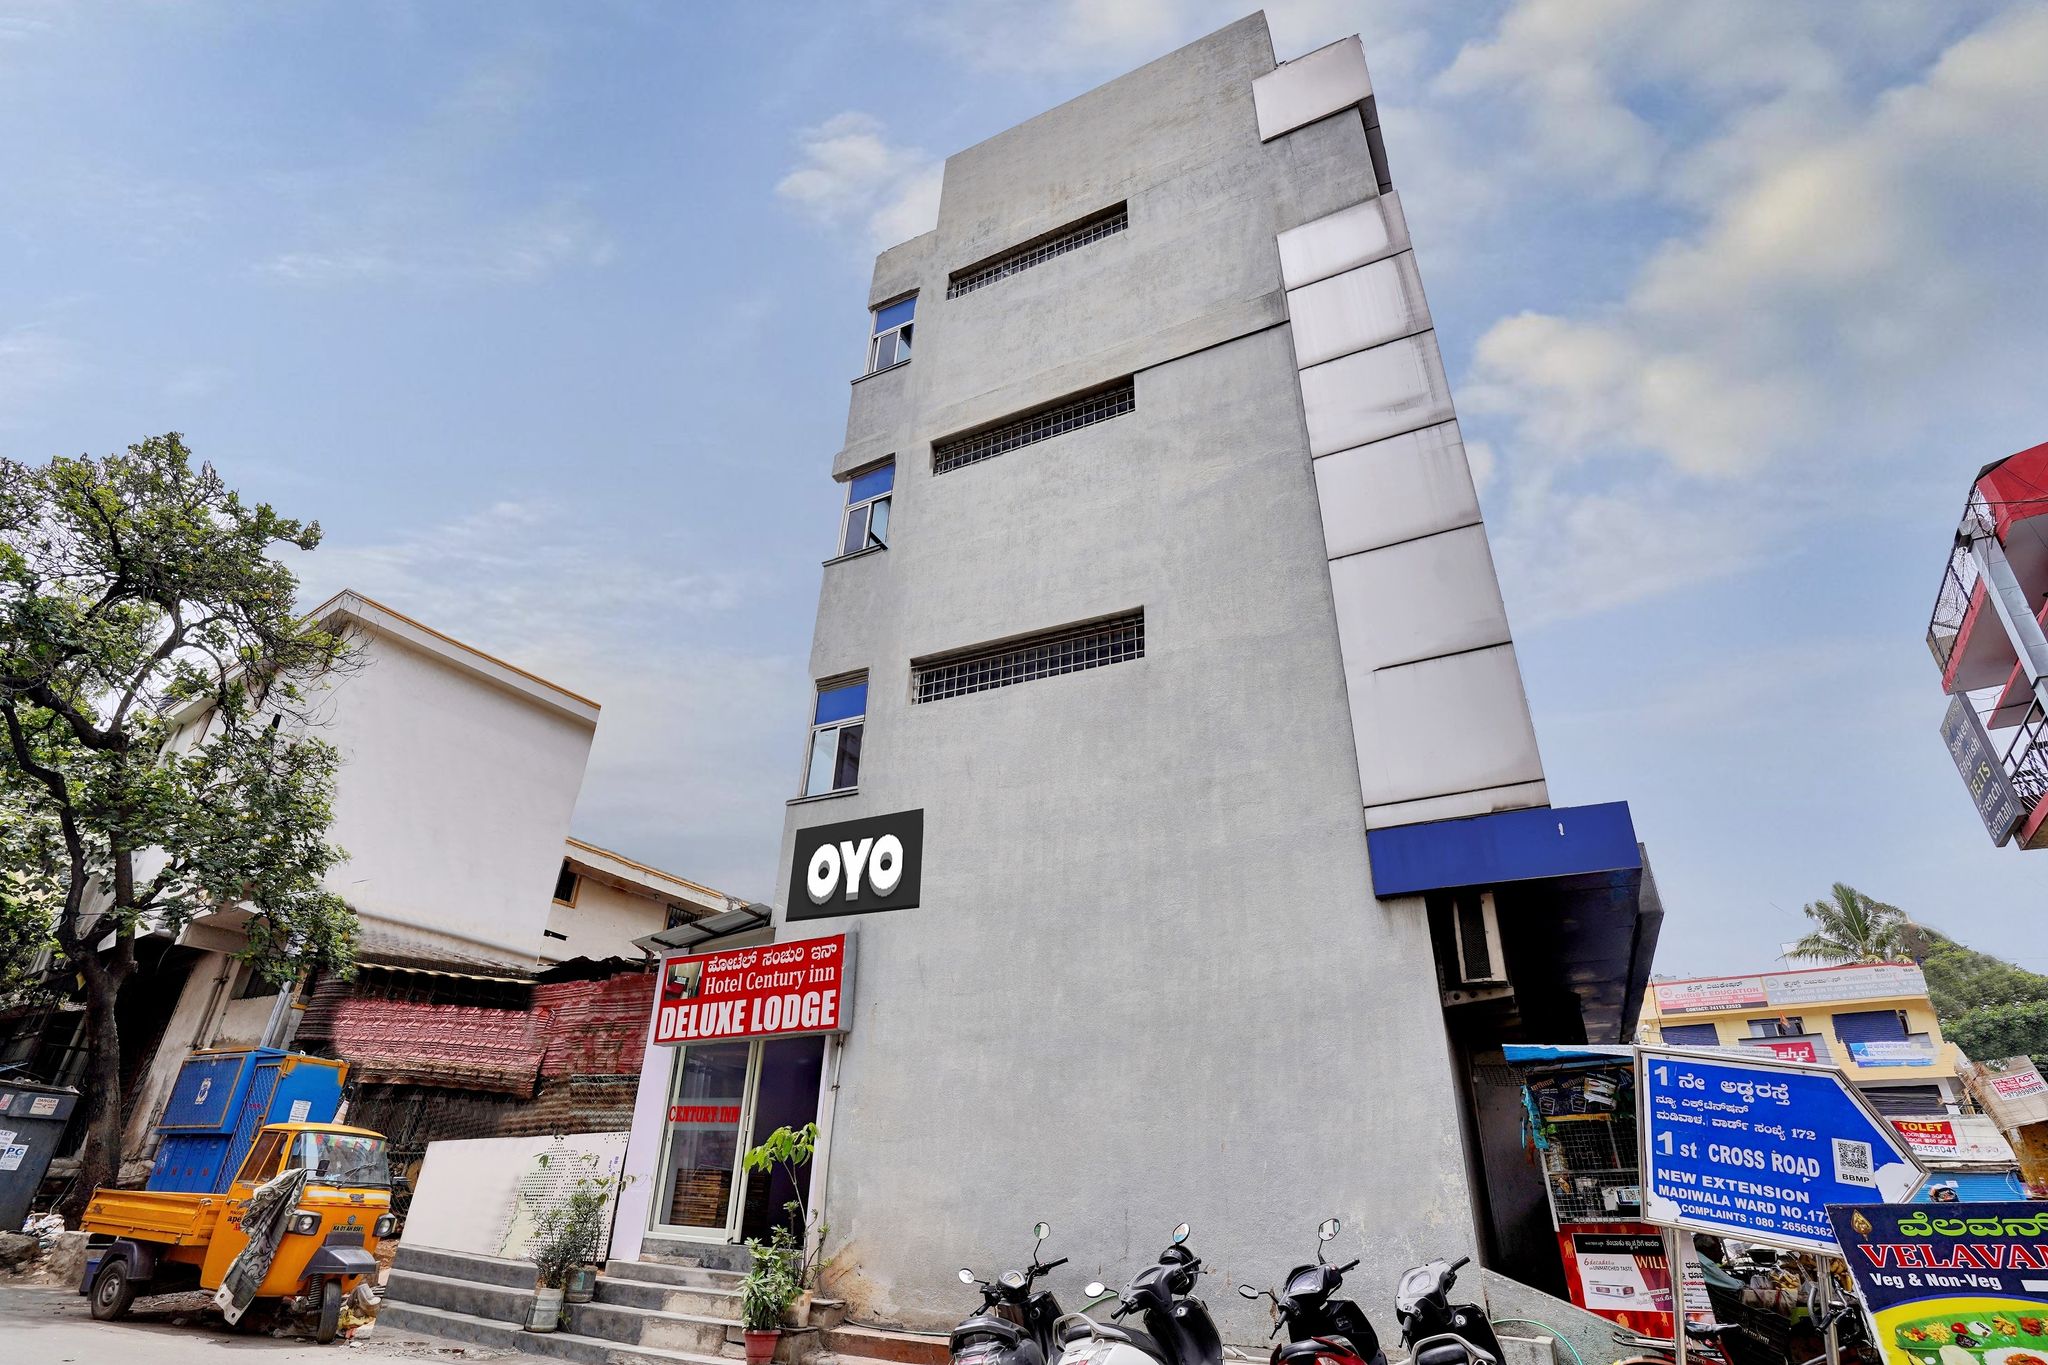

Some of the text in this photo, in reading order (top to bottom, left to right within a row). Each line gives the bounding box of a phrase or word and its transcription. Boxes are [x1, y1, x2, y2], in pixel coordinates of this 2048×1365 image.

[1950, 718, 1970, 757] Spoken
[1958, 737, 1981, 778] English
[1970, 760, 1991, 800] IELTS
[1978, 781, 2003, 820] French
[1987, 800, 2013, 840] German
[807, 834, 903, 904] OYO
[704, 964, 834, 995] Hotel Century inn
[1674, 990, 1706, 999] CHRIST
[1709, 987, 1760, 996] EDUCATION
[658, 989, 837, 1040] DELUXE LODGE
[1654, 1065, 1669, 1086] 1
[1678, 1073, 1706, 1090] ನೇ
[669, 1105, 741, 1124] CENTURY INN
[1900, 1122, 1943, 1132] TOLET
[1791, 1128, 1817, 1141] 172
[6, 1147, 25, 1156] PG
[1656, 1131, 1821, 1178] 1 st CROSS ROAD
[1658, 1168, 1810, 1204] NEW EXTENSION
[1842, 1173, 1870, 1183] BBMP
[1658, 1184, 1731, 1207] MADIWALA
[1735, 1196, 1777, 1215] WARD
[1681, 1204, 1747, 1223] COMPLAINTS
[1755, 1216, 1775, 1228] 080
[1584, 1257, 1590, 1266] 6
[1635, 1255, 1667, 1269] WILL
[1870, 1273, 2003, 1291] Veg & Non-Veg
